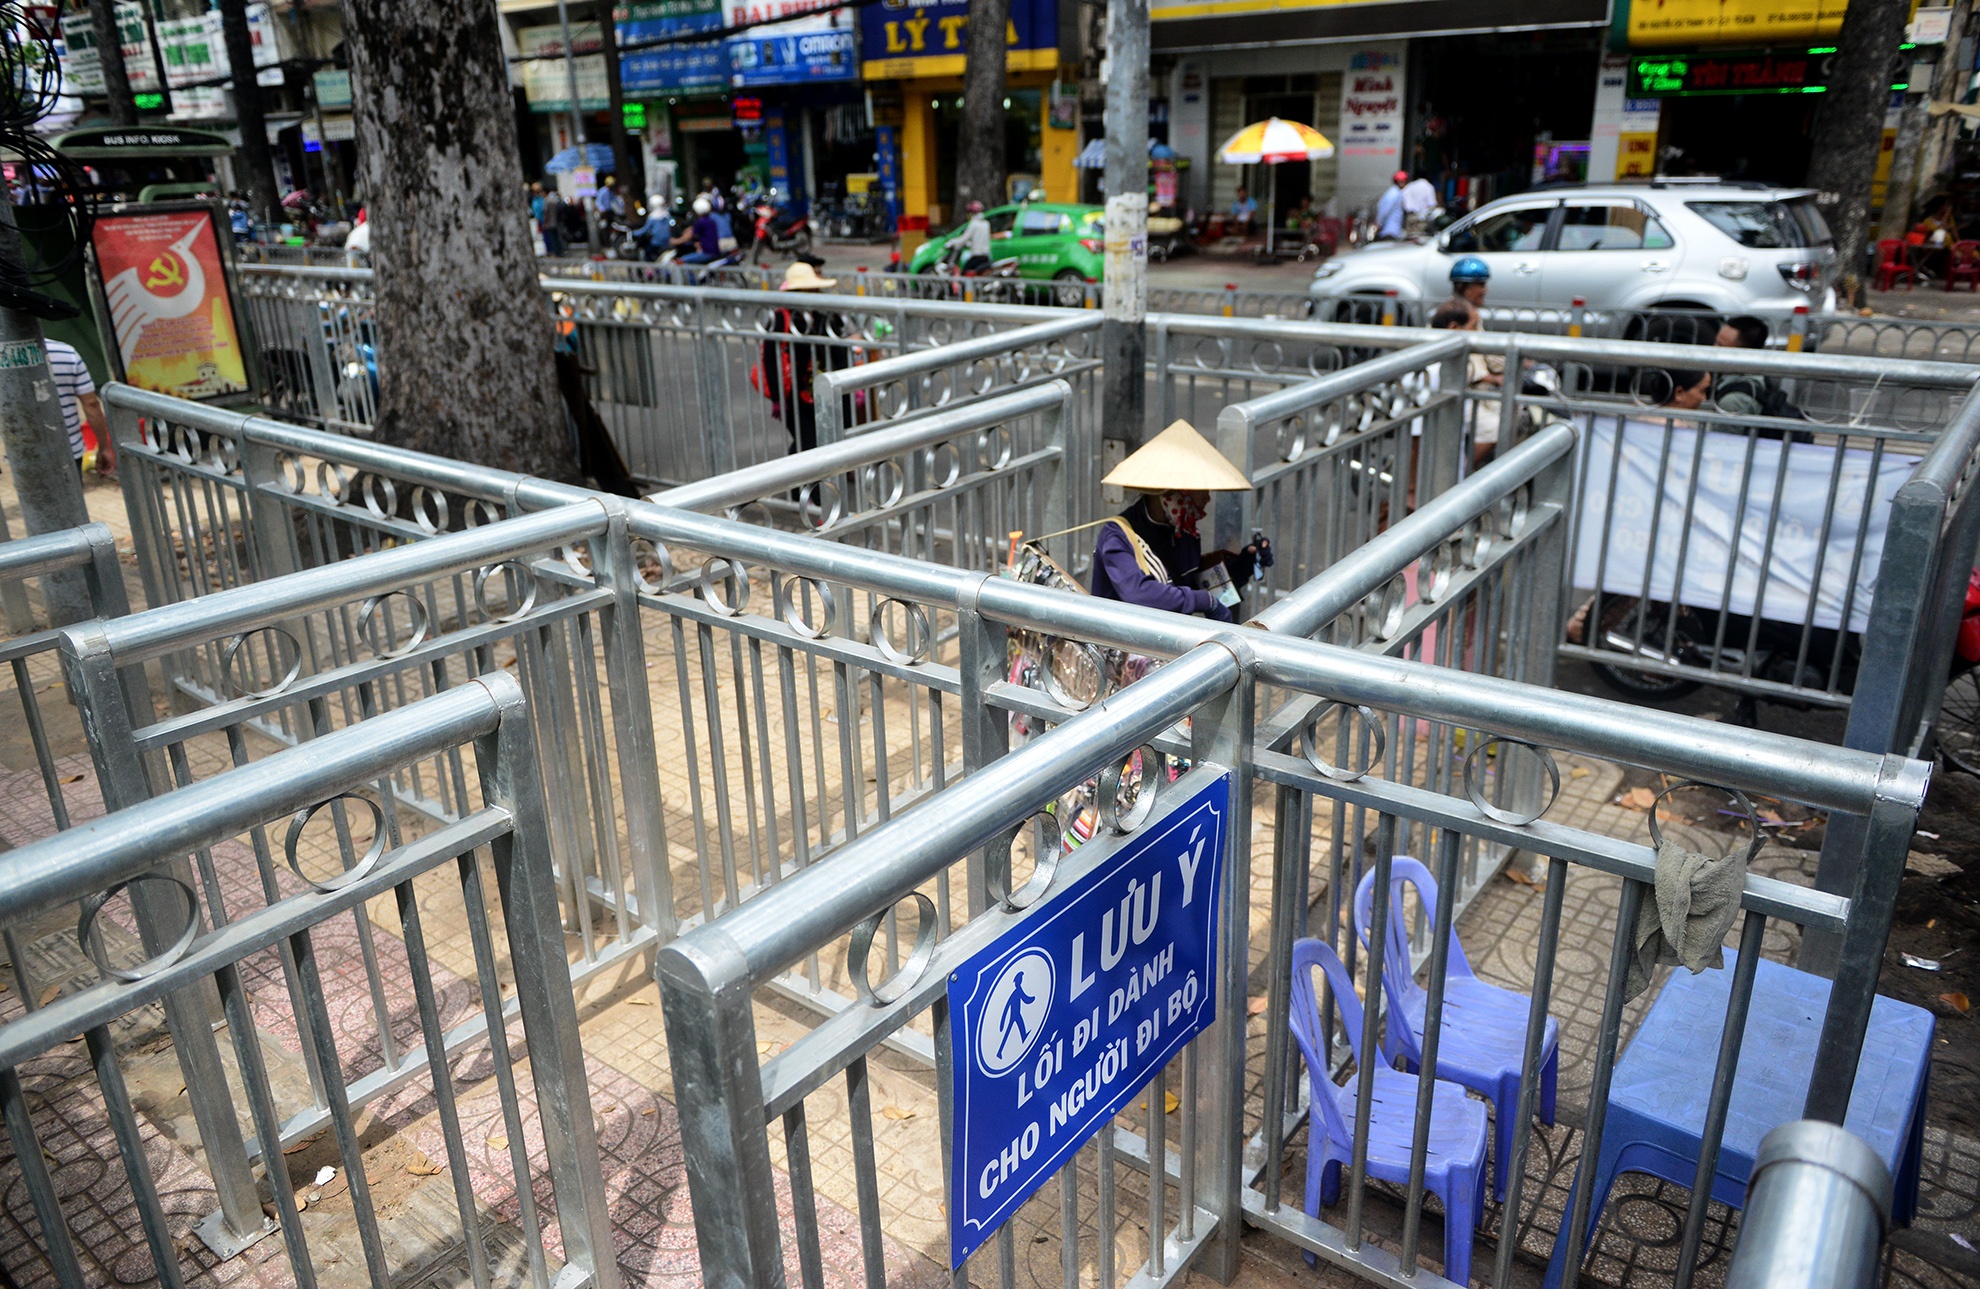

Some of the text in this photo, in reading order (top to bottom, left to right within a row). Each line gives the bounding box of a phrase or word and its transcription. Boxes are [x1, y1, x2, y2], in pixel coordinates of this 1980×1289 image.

[884, 8, 930, 53] LÝ
[104, 135, 125, 145] BUS
[151, 135, 180, 145] KIOSK
[1070, 824, 1206, 1003] LƯU Ý
[979, 969, 1198, 1199] CHO NGƯỜI ĐI BỘ
[1018, 941, 1174, 1109] LỐI ĐI DÀNH
